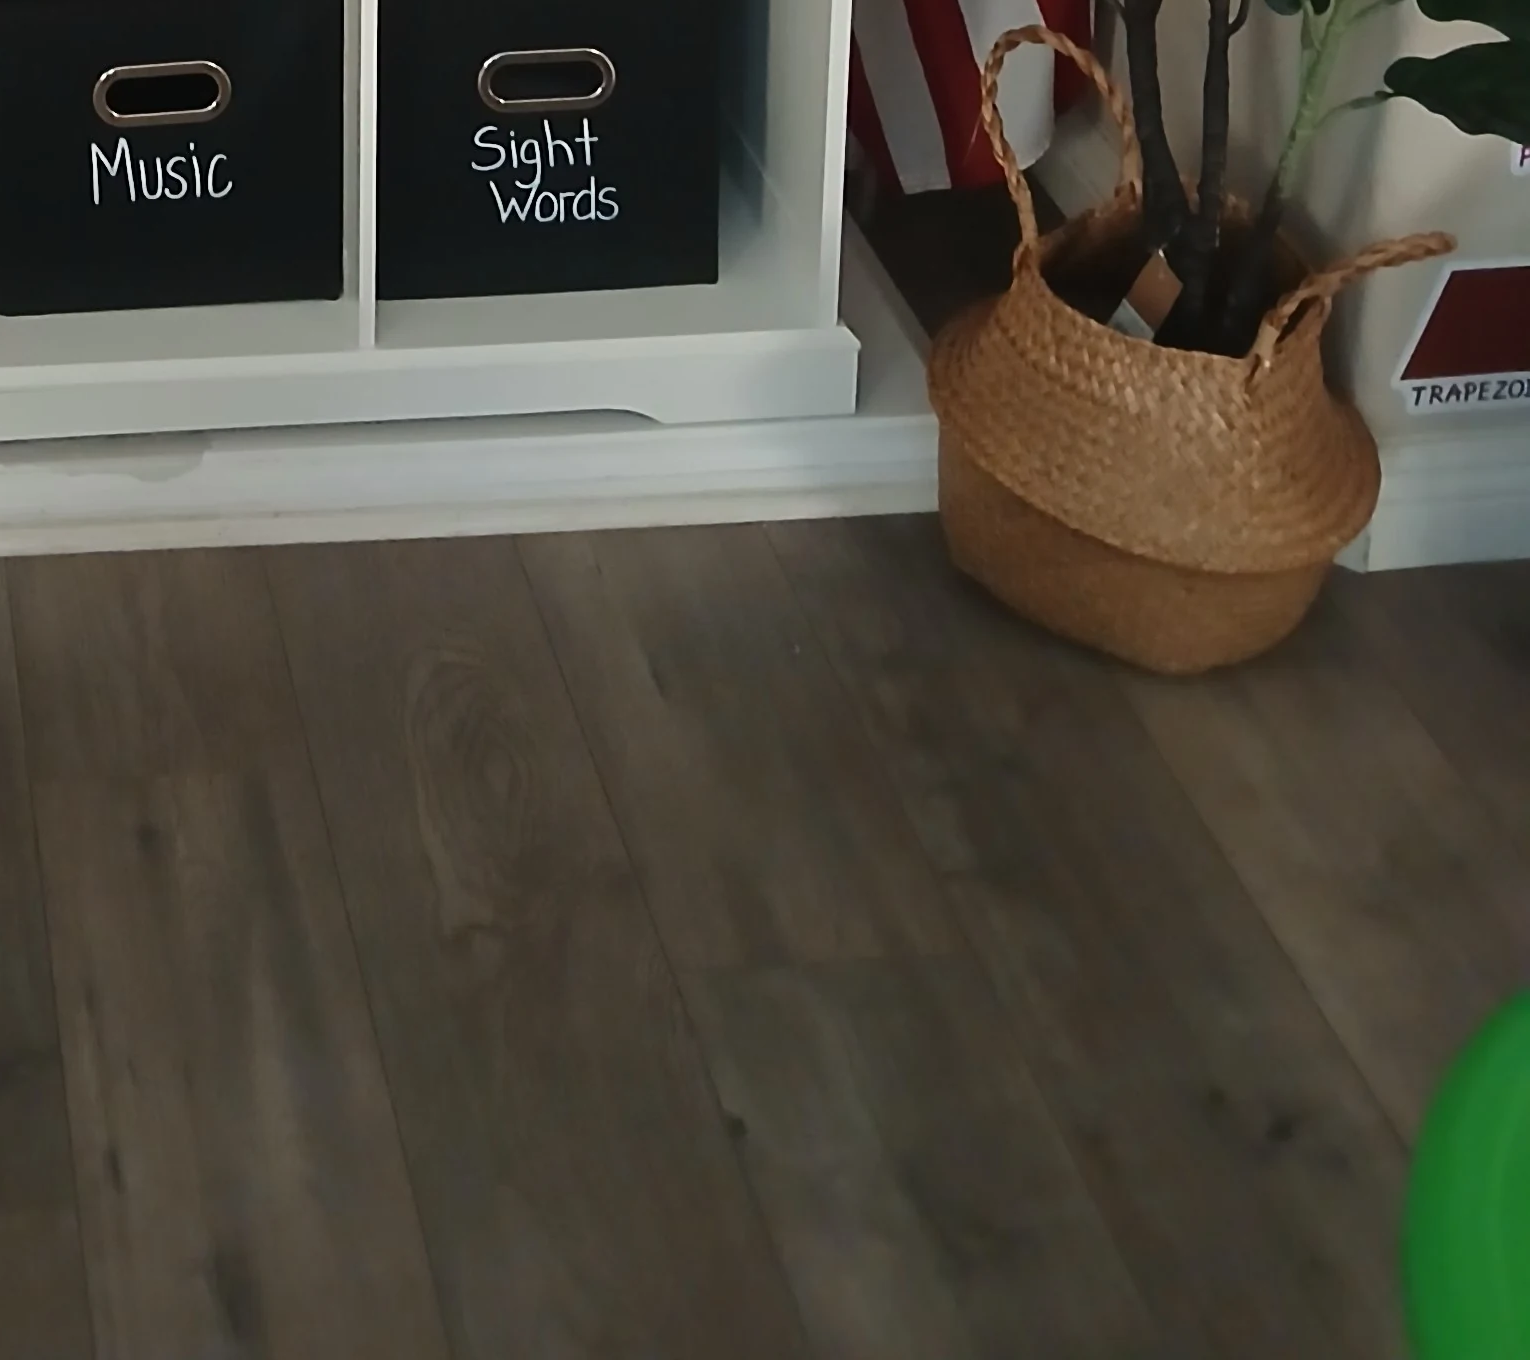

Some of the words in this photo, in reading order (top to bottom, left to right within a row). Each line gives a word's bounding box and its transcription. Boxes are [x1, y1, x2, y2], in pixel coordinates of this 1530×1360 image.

[89, 136, 234, 206] Music
[470, 116, 600, 190] Sight
[488, 174, 620, 224] Words
